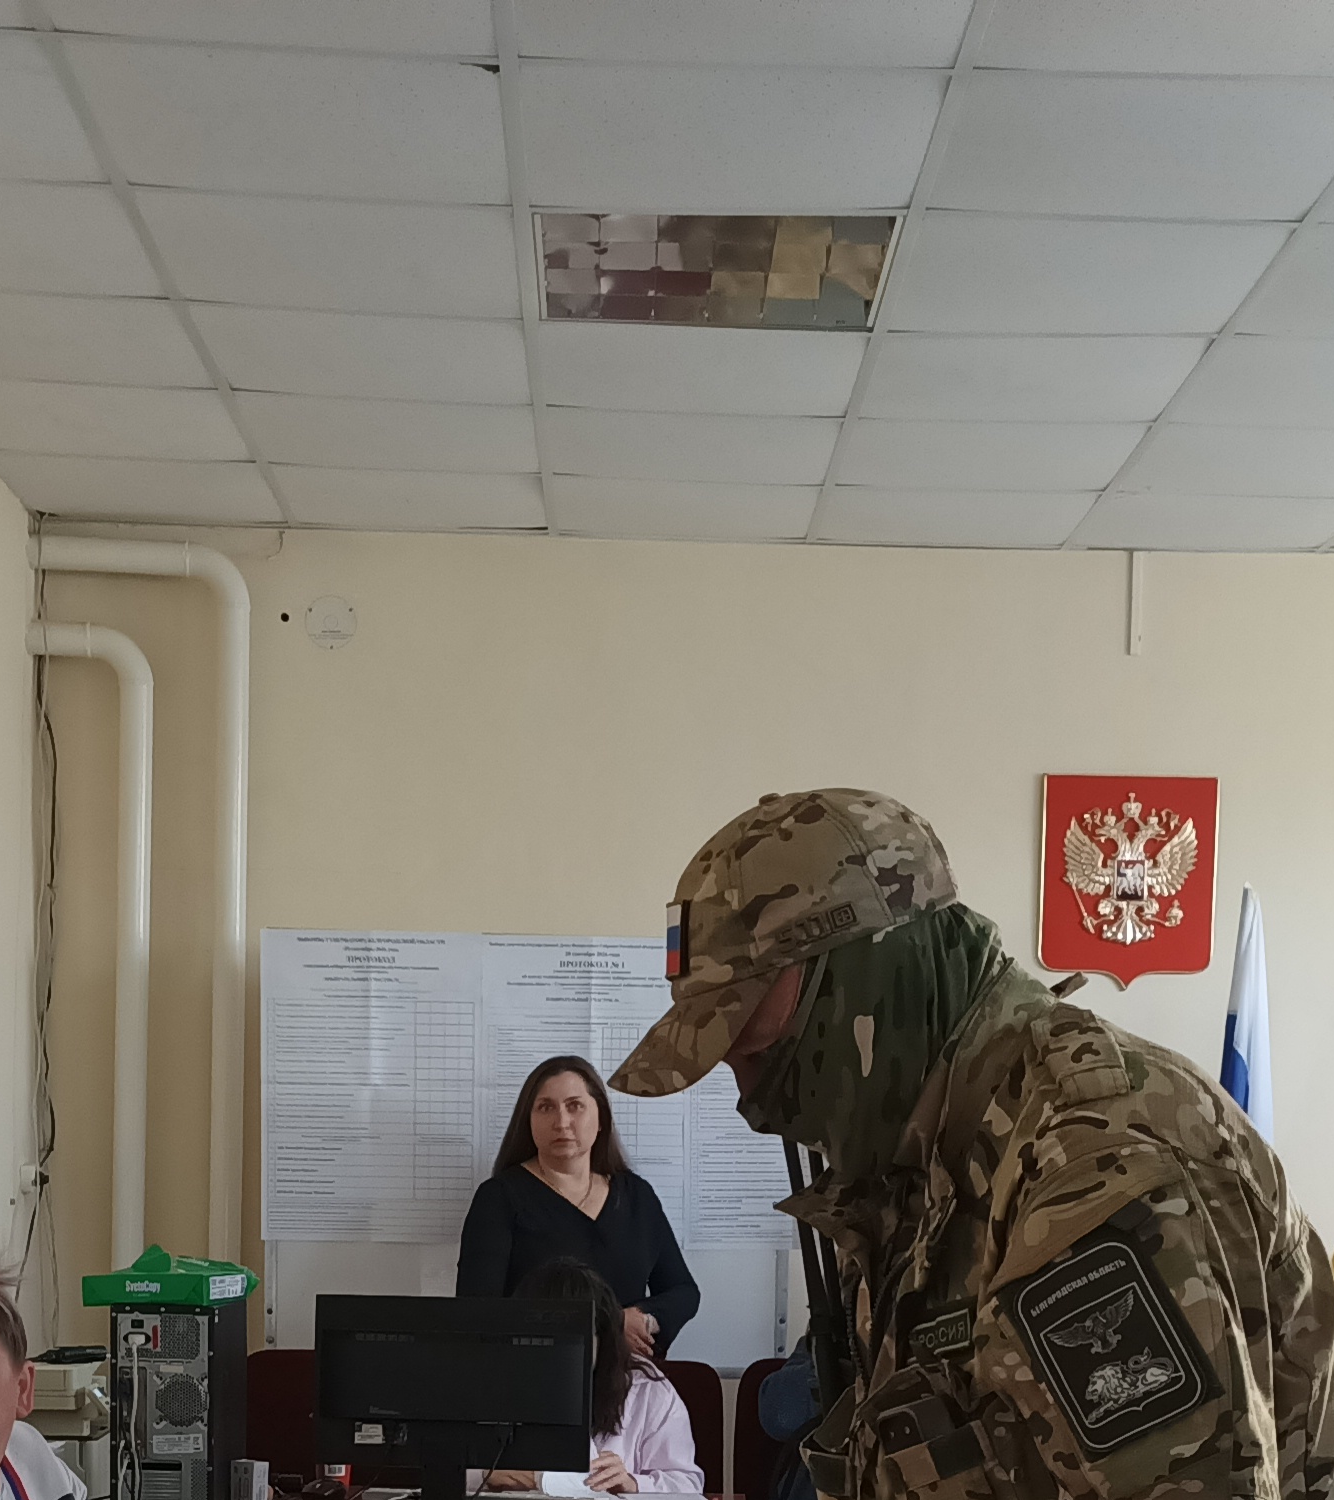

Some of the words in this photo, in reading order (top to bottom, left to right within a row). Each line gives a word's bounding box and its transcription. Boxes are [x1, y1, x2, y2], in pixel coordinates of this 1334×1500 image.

[559, 960, 609, 969] ПРОТОКОЛ
[1087, 1258, 1127, 1282] ОБЛАСТЬ
[125, 1280, 161, 1294] SvetoCopy
